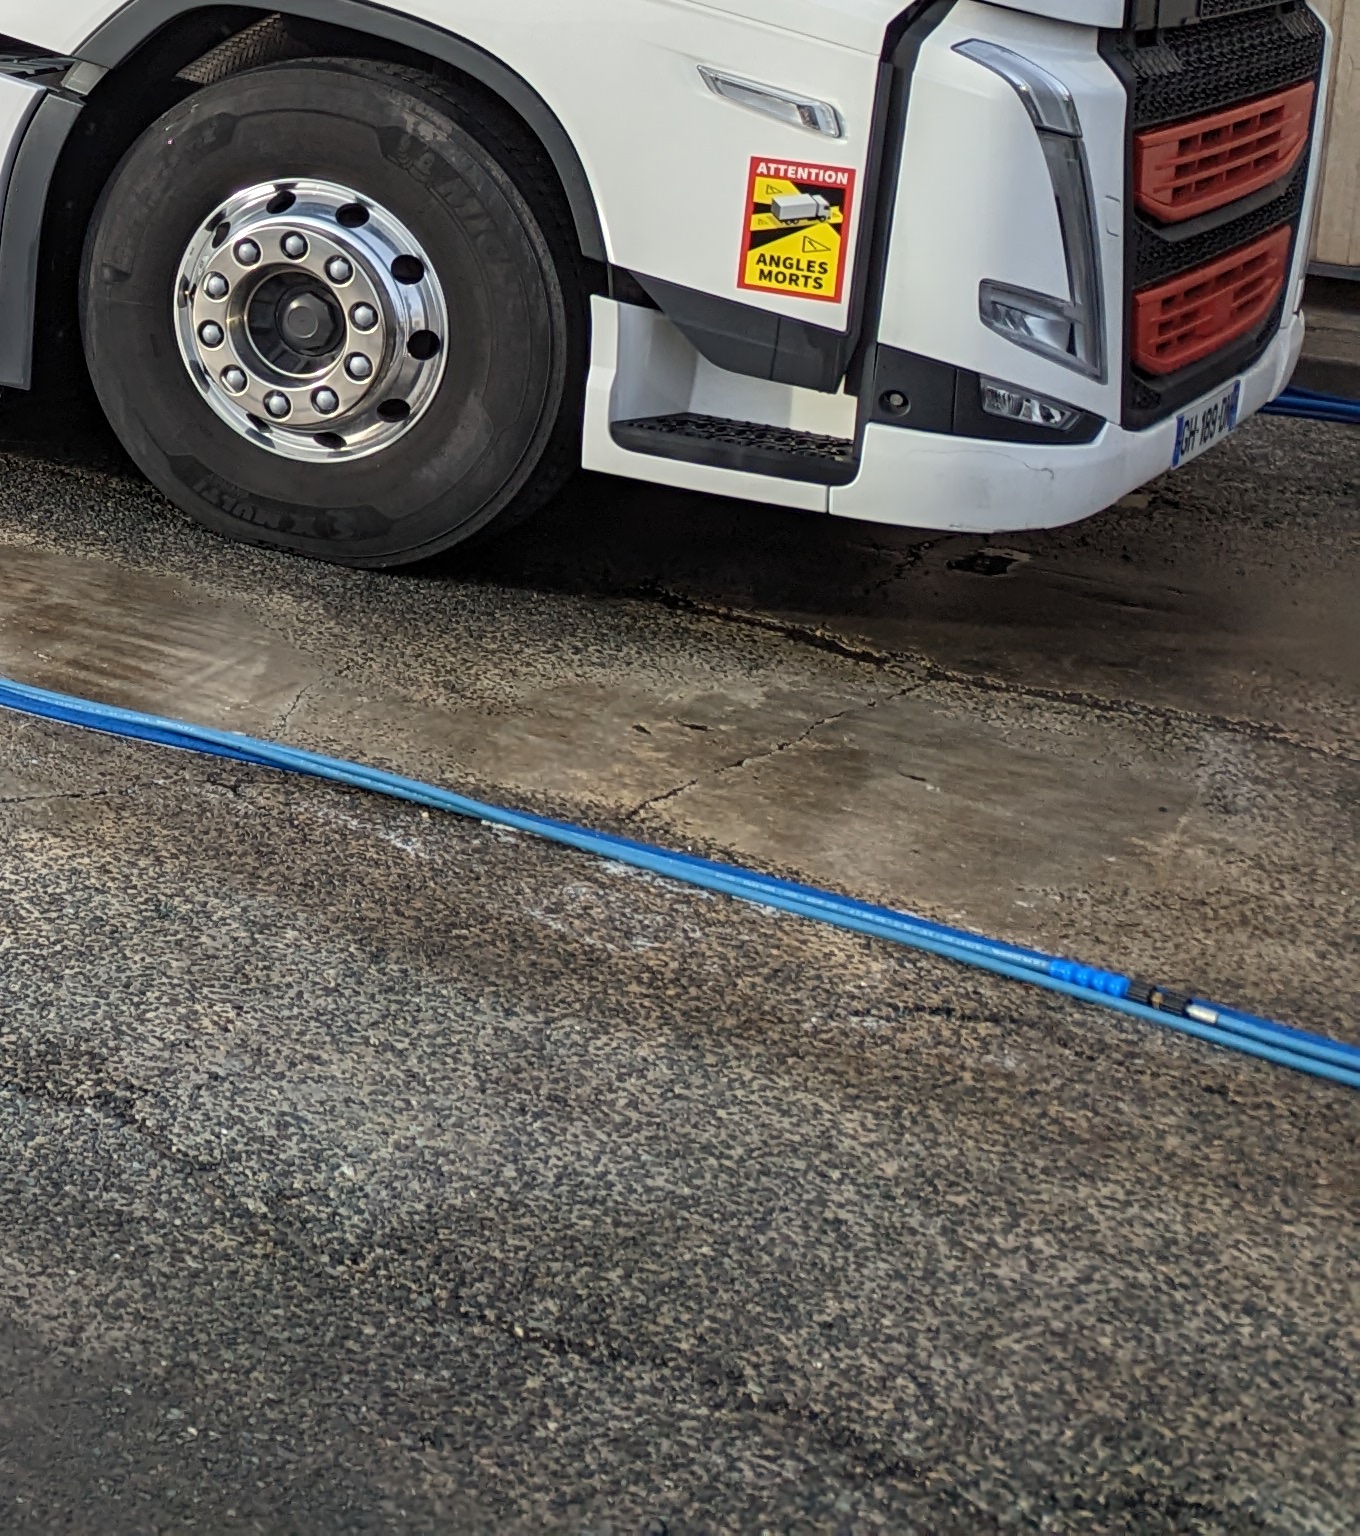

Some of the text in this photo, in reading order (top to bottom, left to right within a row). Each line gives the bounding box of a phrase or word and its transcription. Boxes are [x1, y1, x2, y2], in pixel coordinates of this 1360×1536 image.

[755, 161, 849, 186] ATTENTION
[755, 252, 829, 275] ANGLES
[757, 268, 824, 290] MORTS
